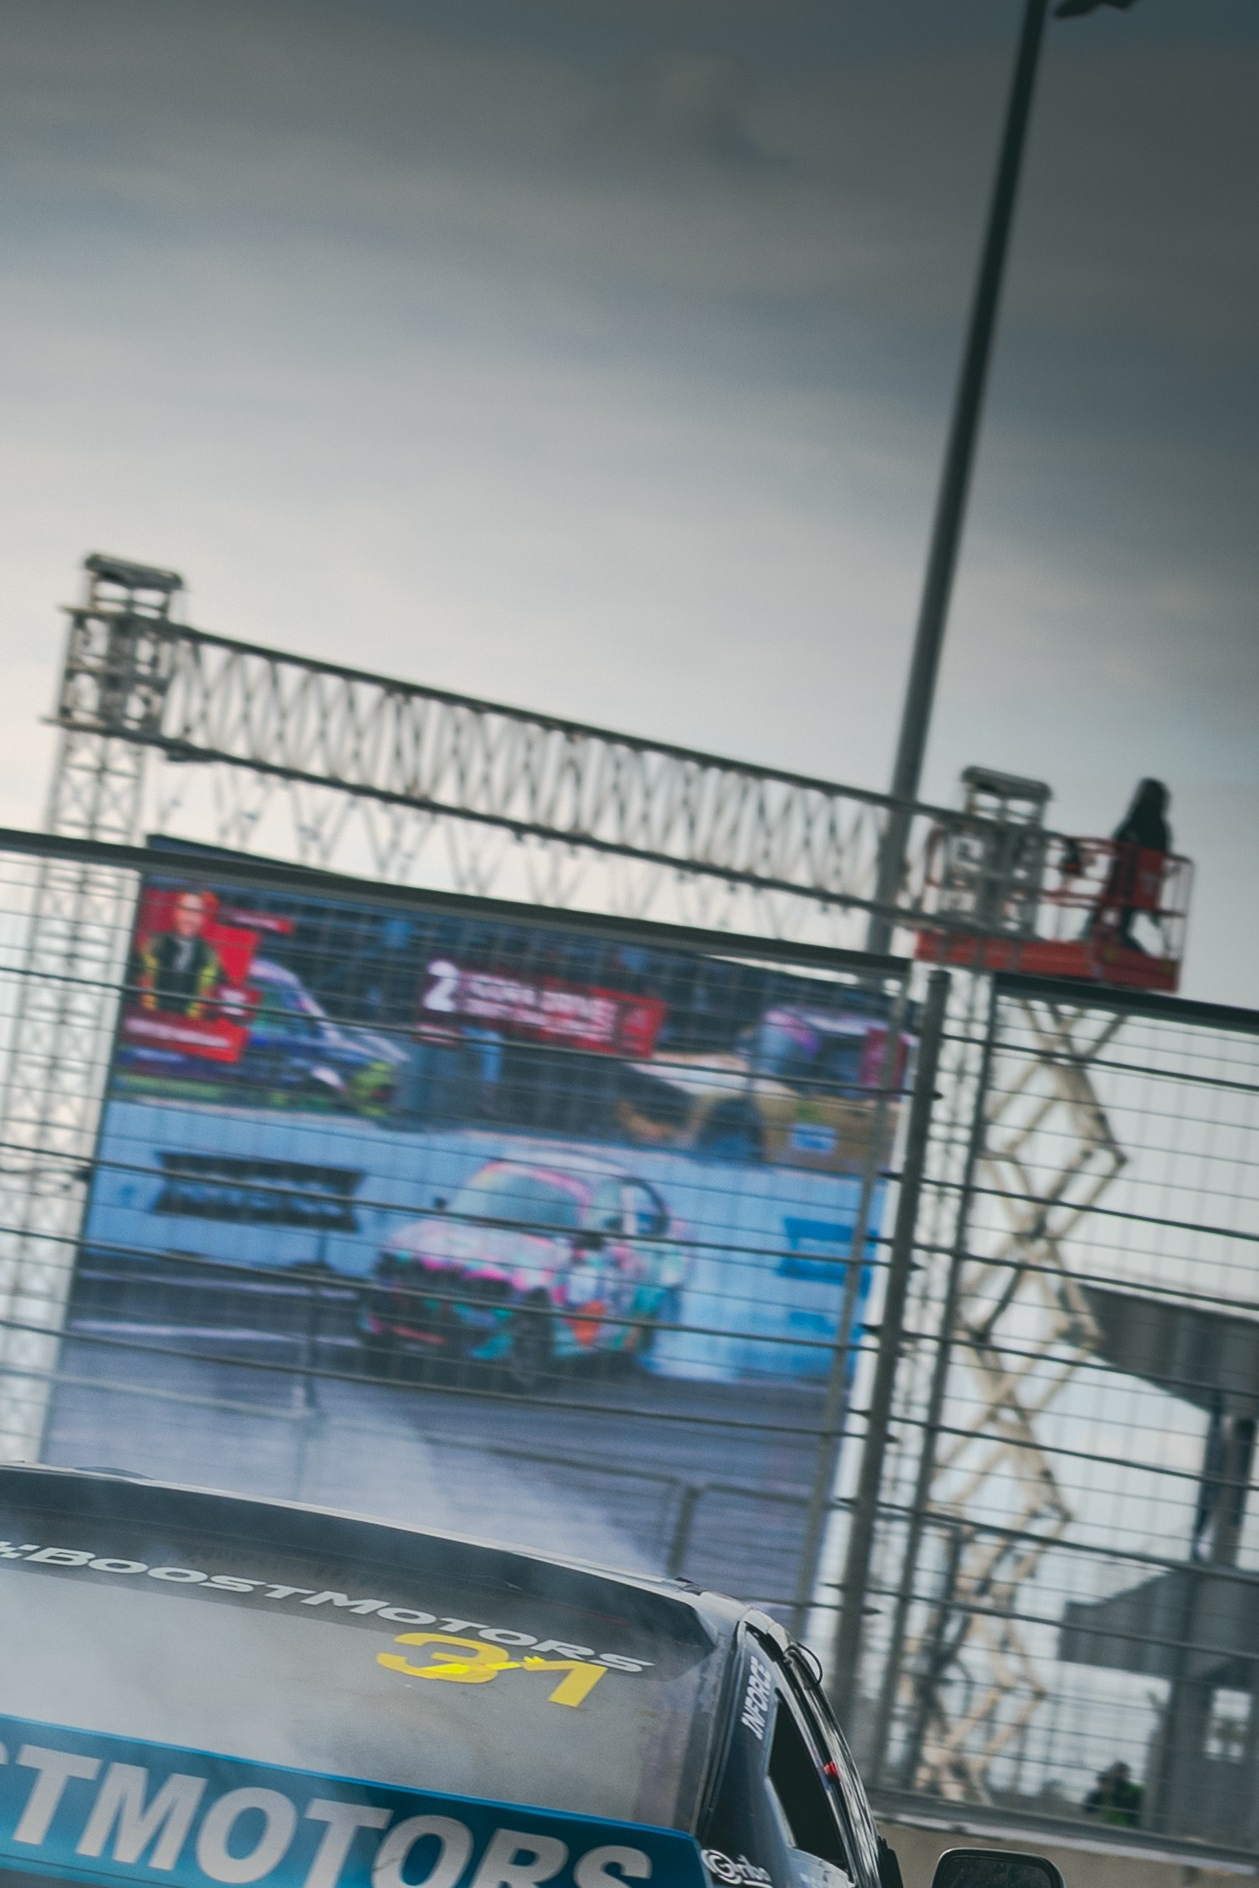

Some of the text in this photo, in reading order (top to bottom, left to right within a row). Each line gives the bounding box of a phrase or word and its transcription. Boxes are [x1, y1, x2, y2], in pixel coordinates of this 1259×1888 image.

[422, 959, 459, 1013] 2
[24, 1547, 655, 1672] BOOSTMOTORS
[376, 1632, 608, 1707] 31
[741, 1655, 771, 1740] INFORCE
